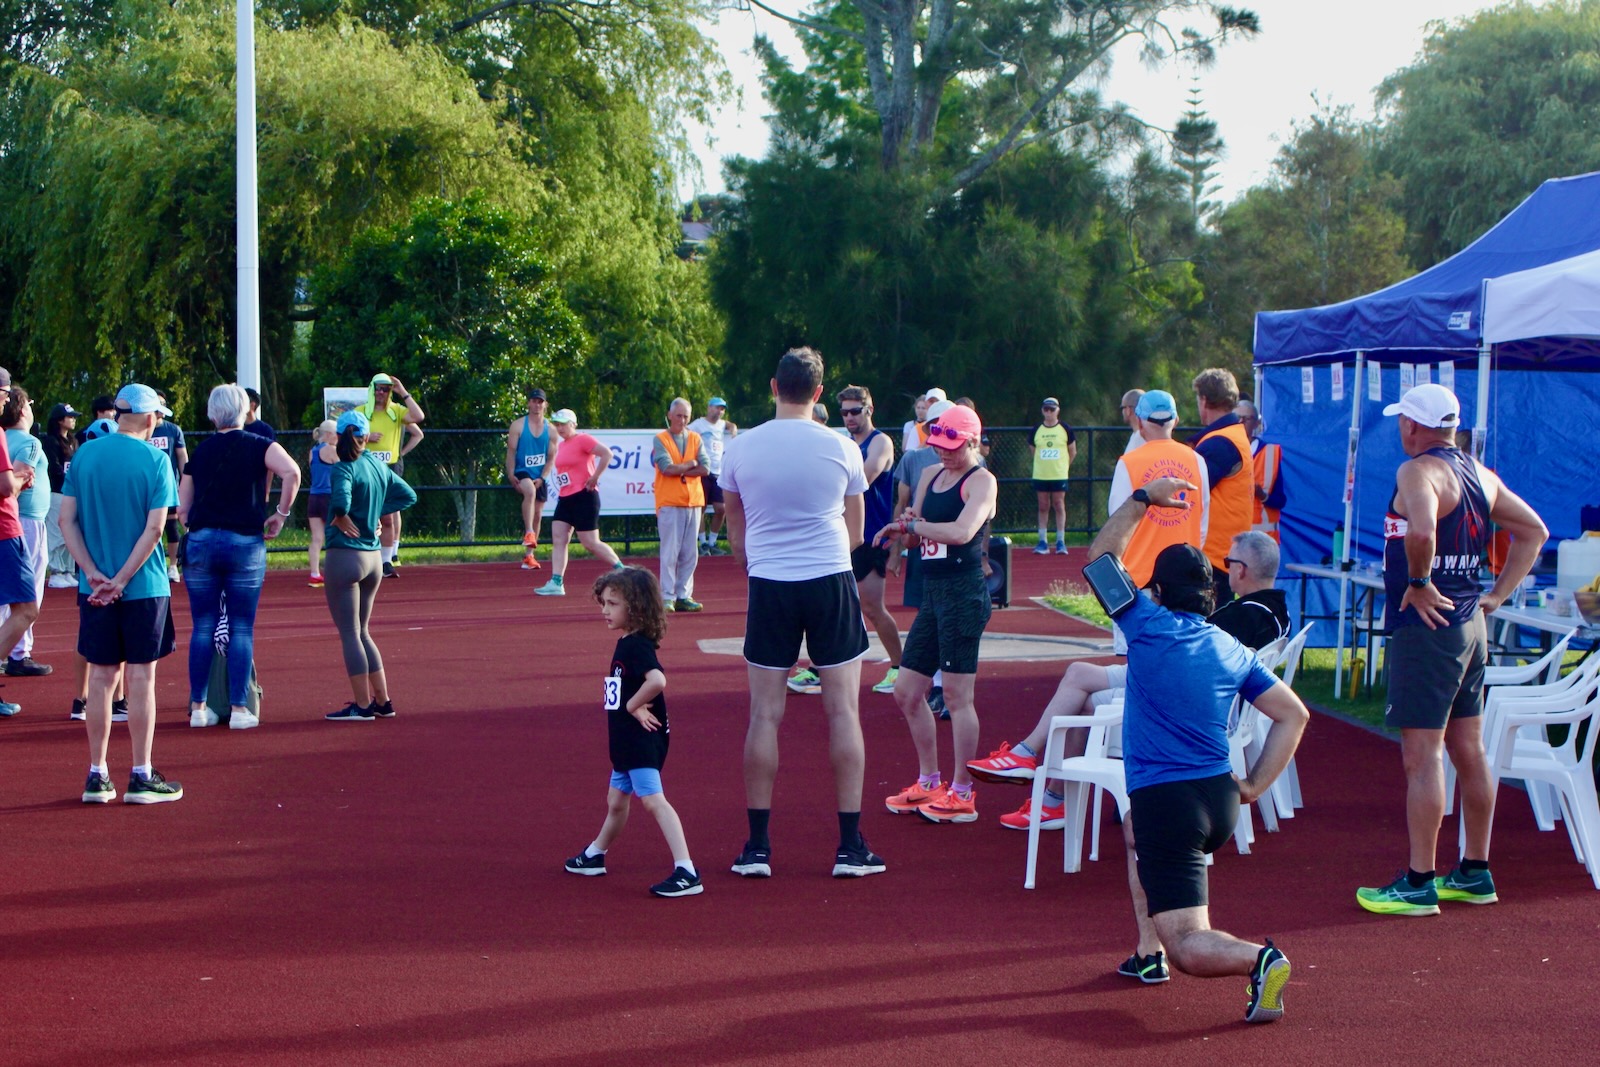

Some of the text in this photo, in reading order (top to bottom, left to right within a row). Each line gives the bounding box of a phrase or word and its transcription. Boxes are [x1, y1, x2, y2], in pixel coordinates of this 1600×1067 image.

[526, 455, 545, 466] 627
[607, 445, 642, 469] Sri
[1042, 449, 1059, 458] 222
[1143, 459, 1193, 483] SRI CHINMOY
